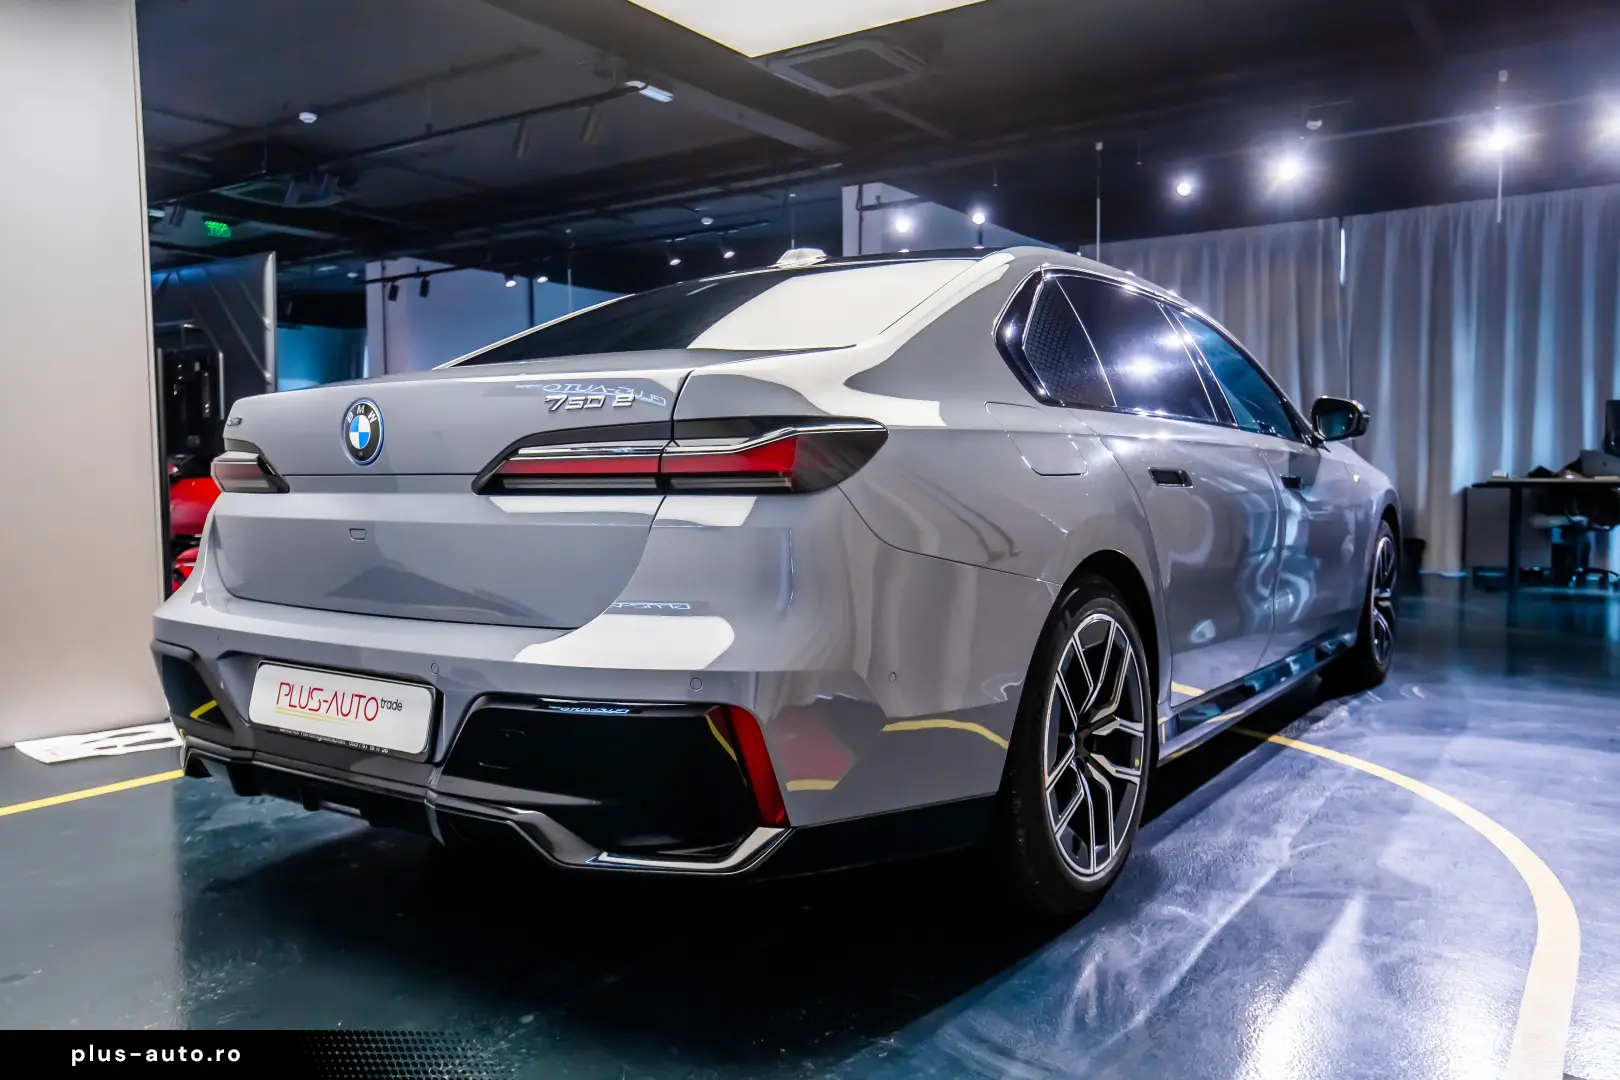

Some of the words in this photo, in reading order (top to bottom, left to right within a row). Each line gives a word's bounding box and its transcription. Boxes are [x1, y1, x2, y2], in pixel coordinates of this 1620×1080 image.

[544, 394, 606, 411] 750
[347, 404, 378, 424] BMW
[276, 682, 379, 721] PLUS-AUTO
[380, 697, 403, 711] trade
